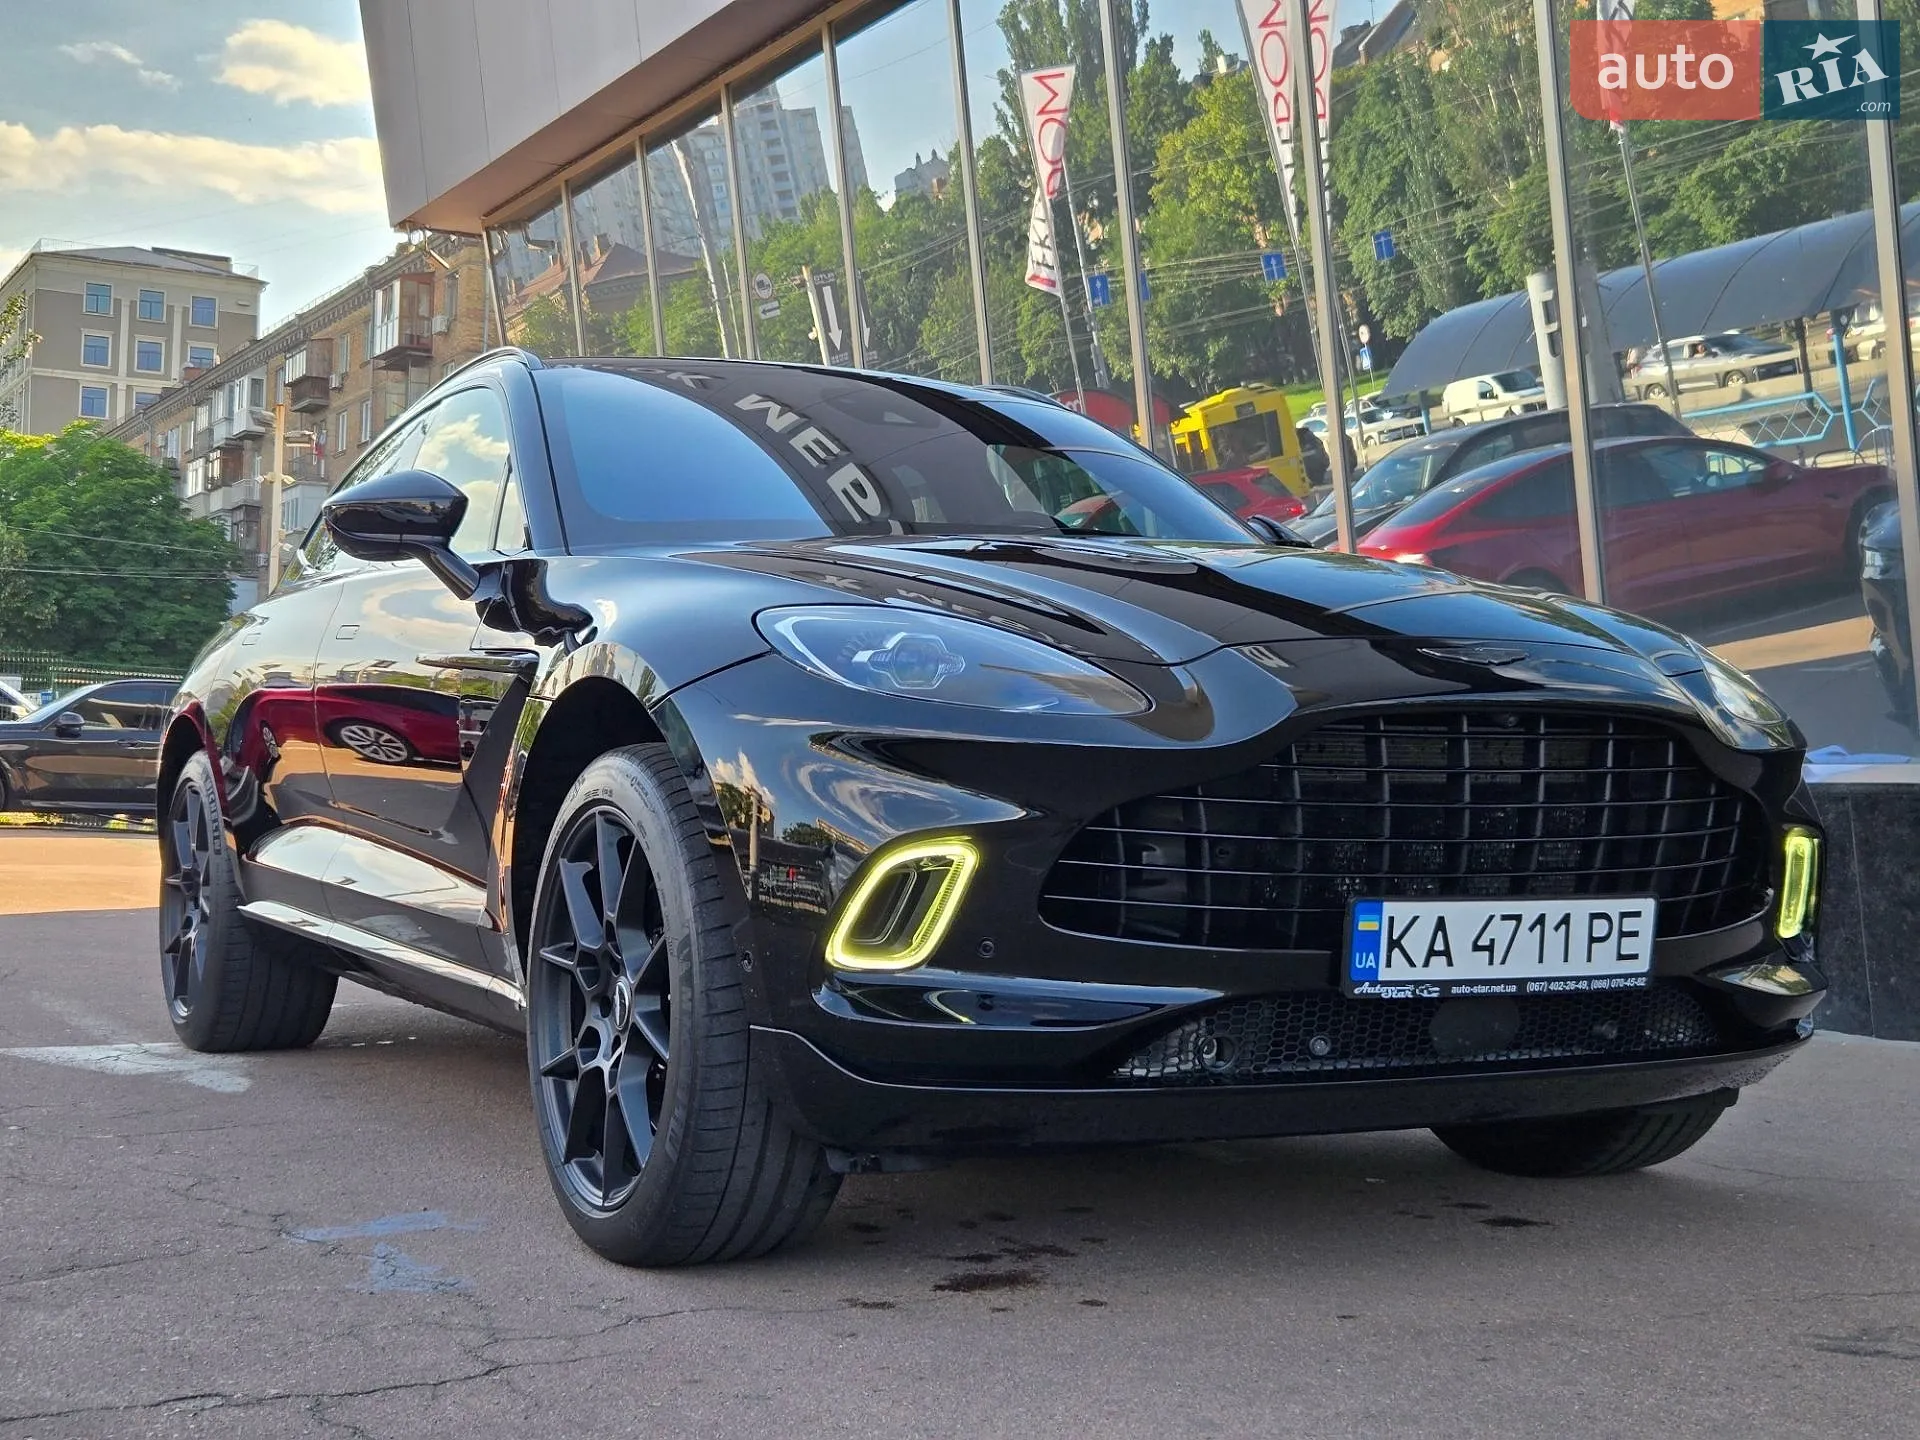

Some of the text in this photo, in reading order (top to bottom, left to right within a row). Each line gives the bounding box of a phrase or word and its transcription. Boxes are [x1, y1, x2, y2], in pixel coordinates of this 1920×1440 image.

[1384, 910, 1642, 969] KA 4711 PE
[1355, 951, 1377, 969] UA
[1526, 981, 1548, 993] (067)
